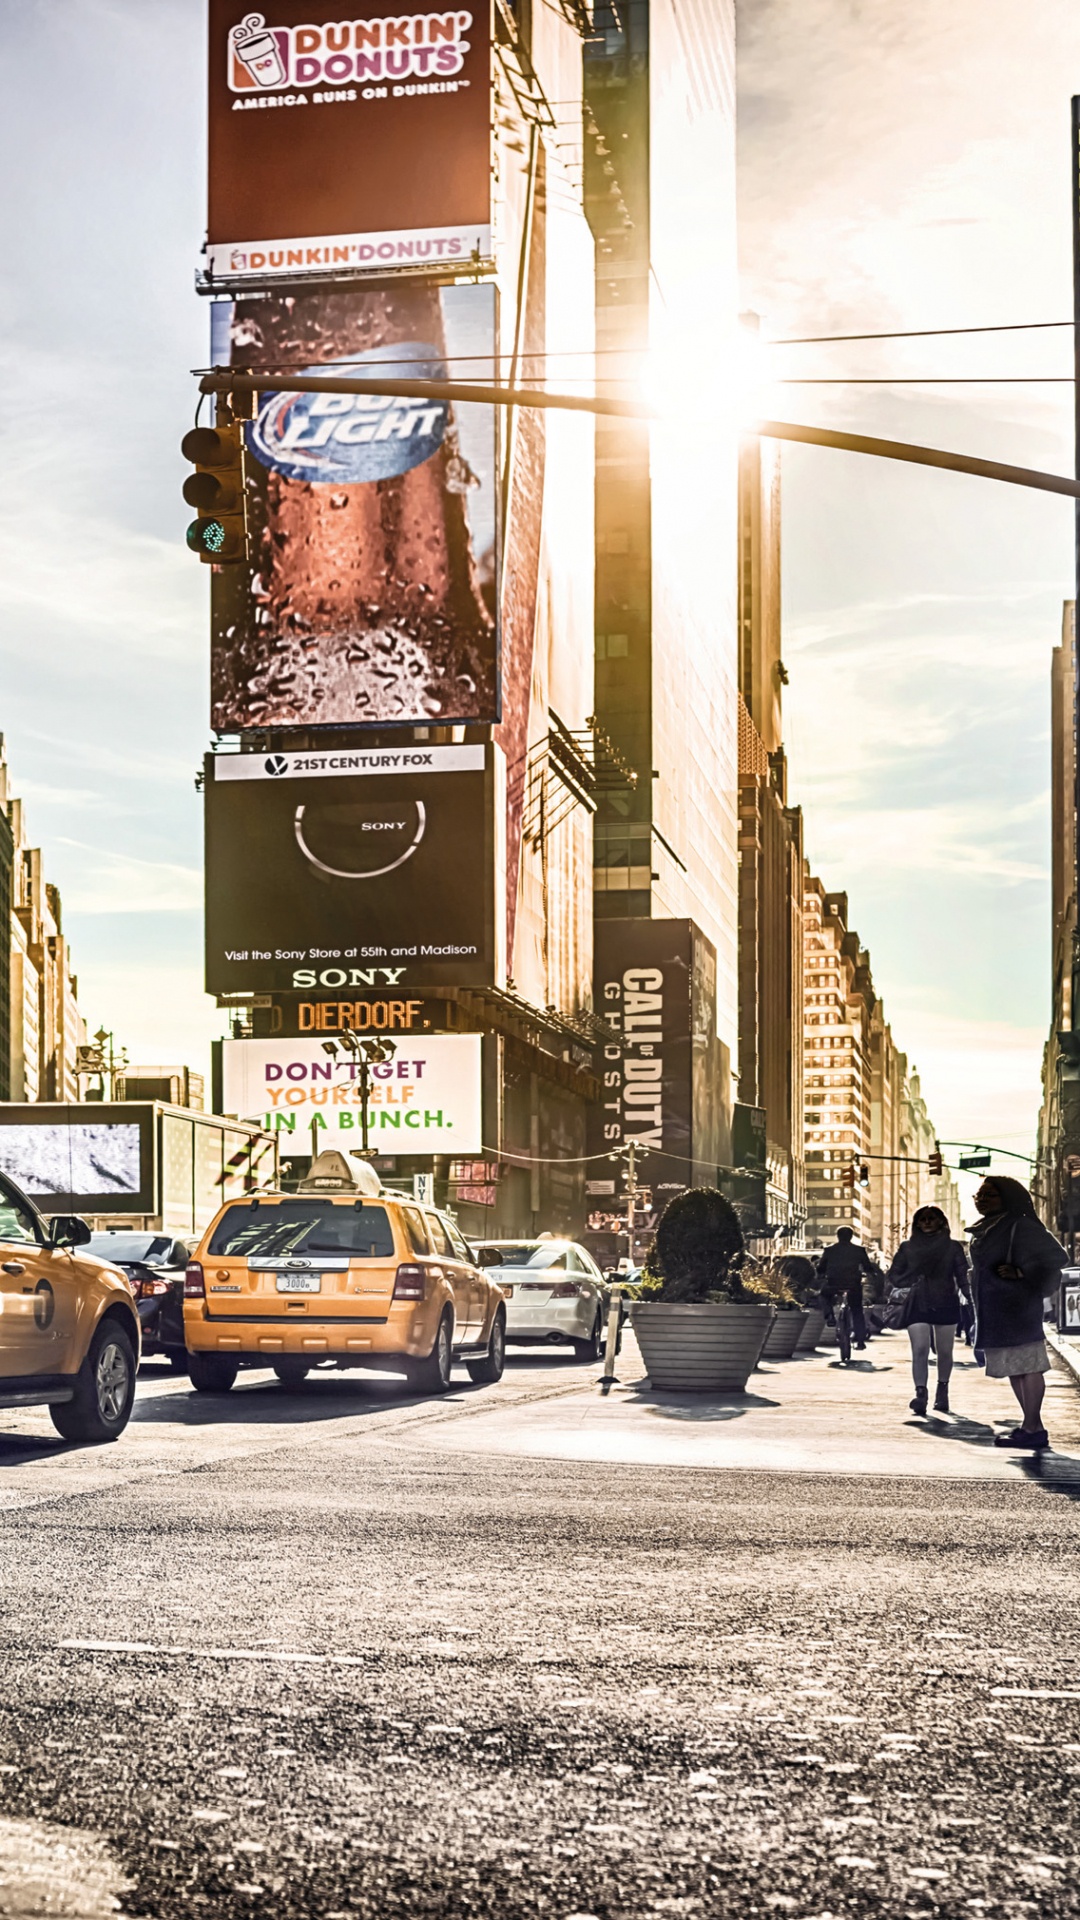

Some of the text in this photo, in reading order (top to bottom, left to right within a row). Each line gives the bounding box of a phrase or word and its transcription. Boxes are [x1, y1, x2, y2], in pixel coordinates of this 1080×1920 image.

[294, 14, 468, 54] DUNKIN'
[294, 44, 460, 83] DONUTS
[231, 80, 460, 111] AMERICA RUNS ON DUNKIN'
[279, 406, 444, 449] LIGHT
[292, 753, 434, 771] 21ST CENTURY FOX
[360, 821, 407, 832] SONY
[224, 943, 478, 961] Visit the Sony Store at 55th and Madison
[292, 967, 407, 989] SONY
[623, 967, 664, 1050] CALL
[603, 981, 622, 1140] GHOSTS
[639, 1043, 655, 1057] OF
[372, 1060, 427, 1080] GET
[265, 1085, 416, 1107] YOURSELF
[623, 1058, 664, 1150] DUTY
[264, 1110, 454, 1131] IN A BUNCH.
